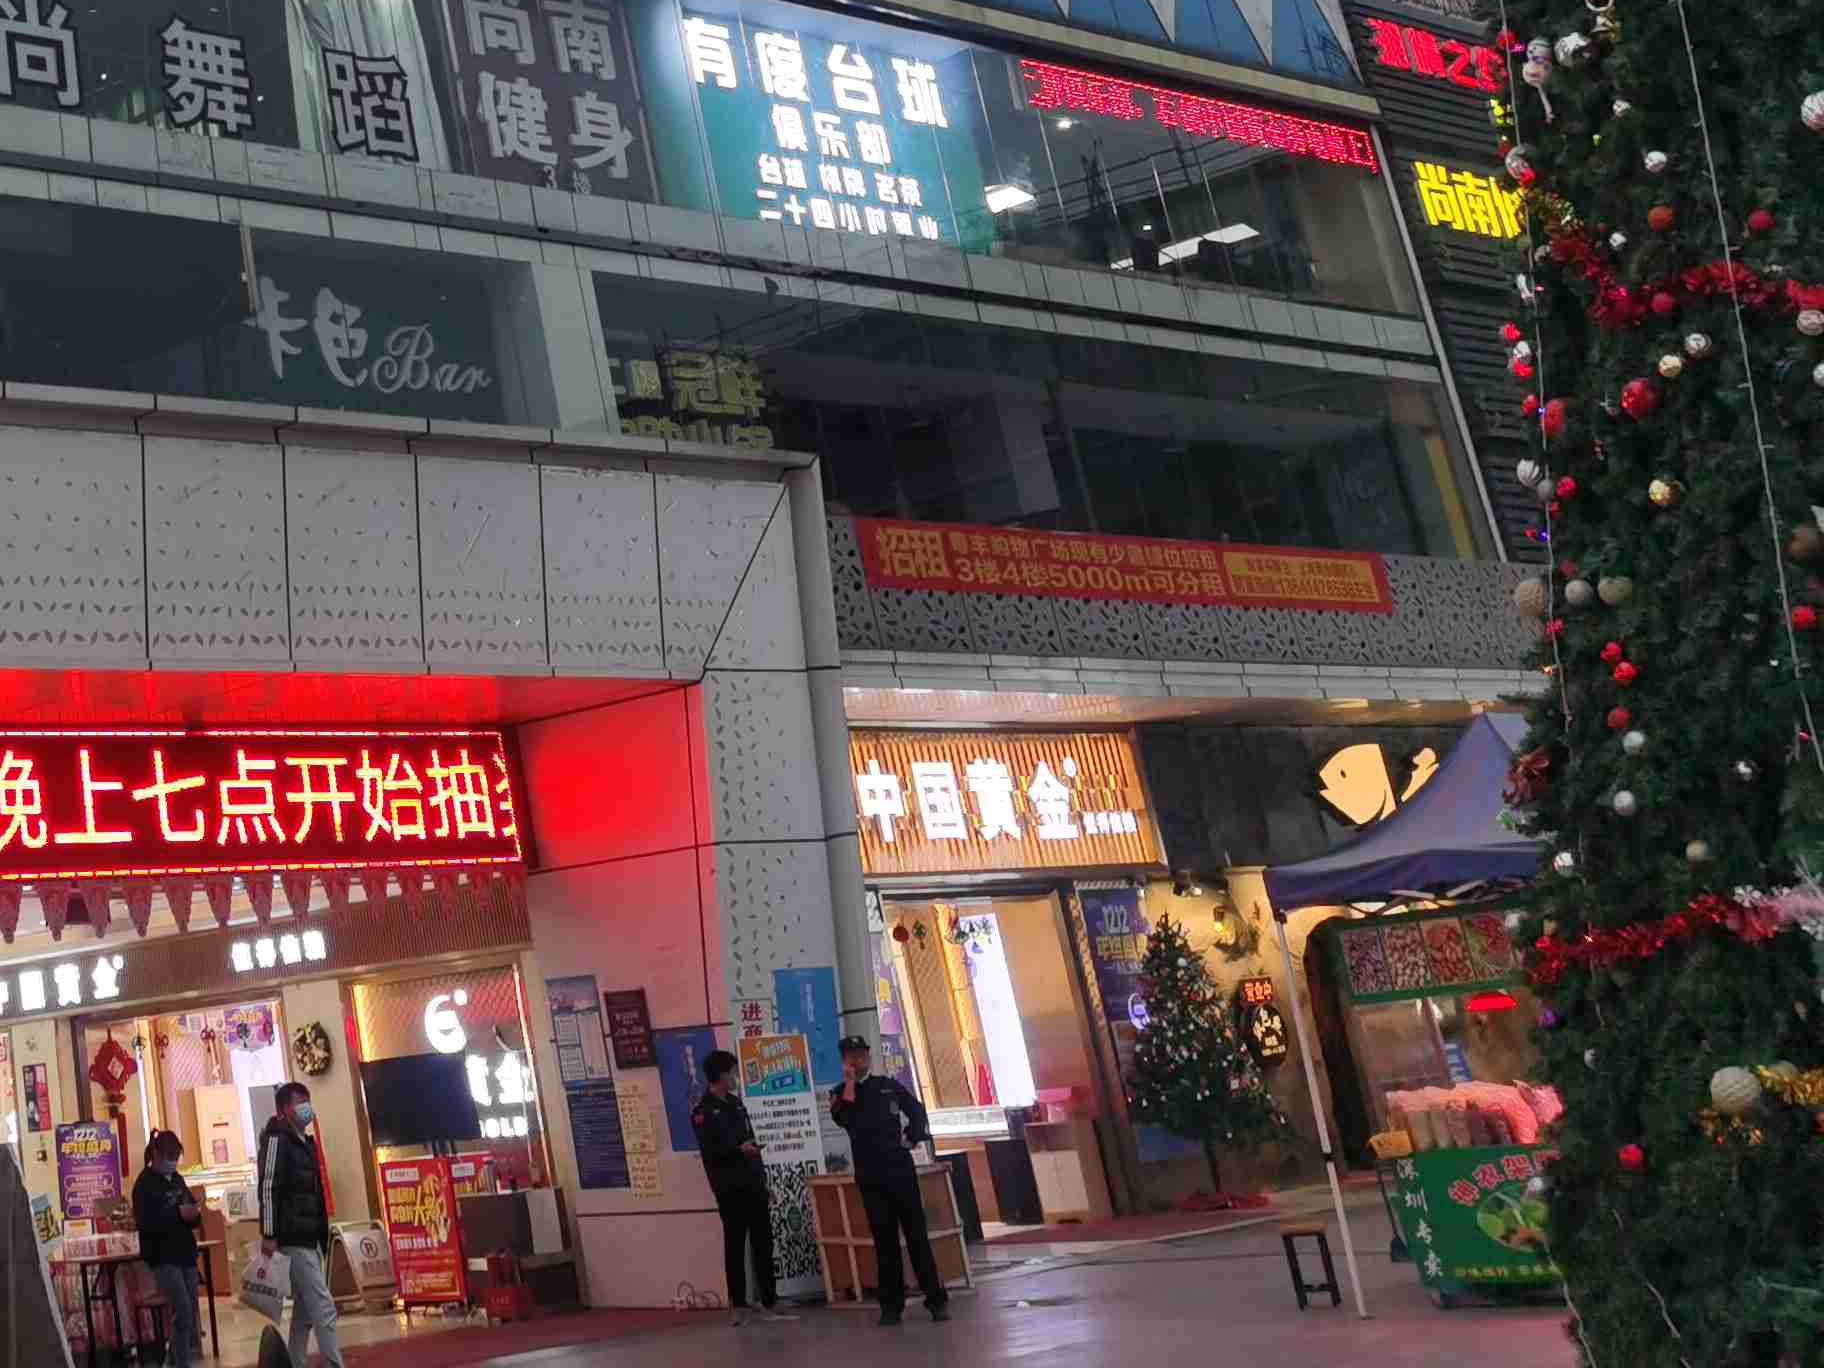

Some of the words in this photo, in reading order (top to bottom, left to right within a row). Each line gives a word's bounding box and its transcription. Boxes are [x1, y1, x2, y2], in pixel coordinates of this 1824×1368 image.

[682, 15, 949, 129] 有度台球
[477, 70, 633, 179] 健身
[375, 323, 492, 394] Bar
[879, 528, 952, 578] 招租
[857, 757, 1079, 842] 中国黄金
[479, 1116, 528, 1138] OLD
